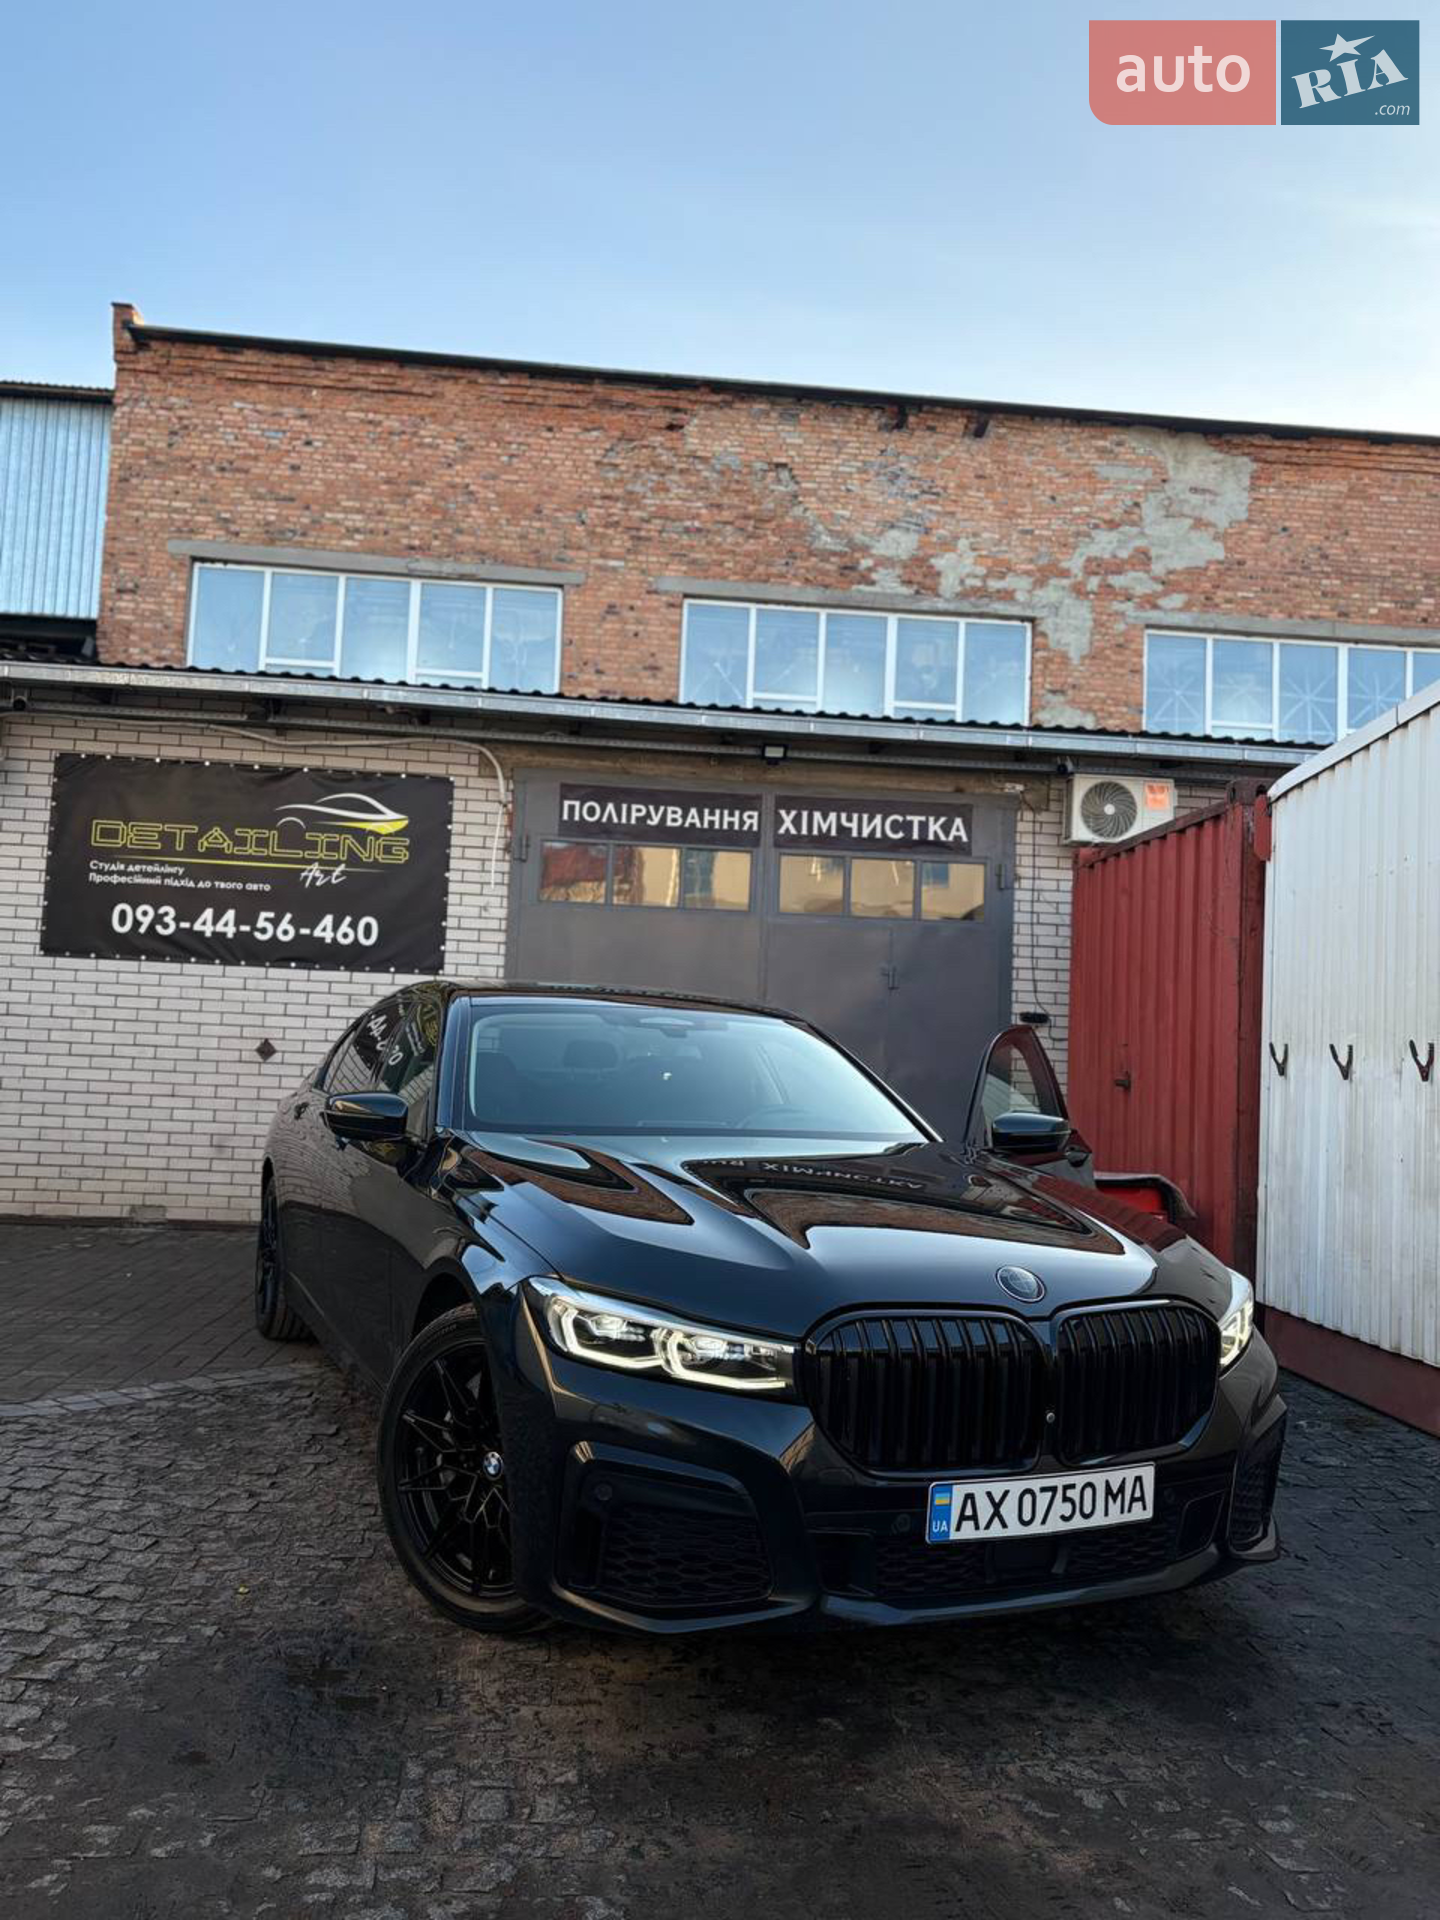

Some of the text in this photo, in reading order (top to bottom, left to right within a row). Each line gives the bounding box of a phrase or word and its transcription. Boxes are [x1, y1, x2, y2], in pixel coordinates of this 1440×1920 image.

[562, 800, 759, 831] ПОЛІРУВАННЯ
[778, 809, 969, 843] ХІМЧИСТКА
[91, 819, 410, 863] DETAILING
[89, 859, 126, 872] Студія
[300, 861, 347, 888] Art
[164, 876, 196, 888] підхід
[197, 881, 212, 889] до
[214, 881, 243, 890] твого
[245, 883, 272, 892] авто
[111, 903, 379, 946] 093-44-56-460
[954, 1475, 1148, 1532] AX 0750 MA
[932, 1520, 948, 1533] UA
